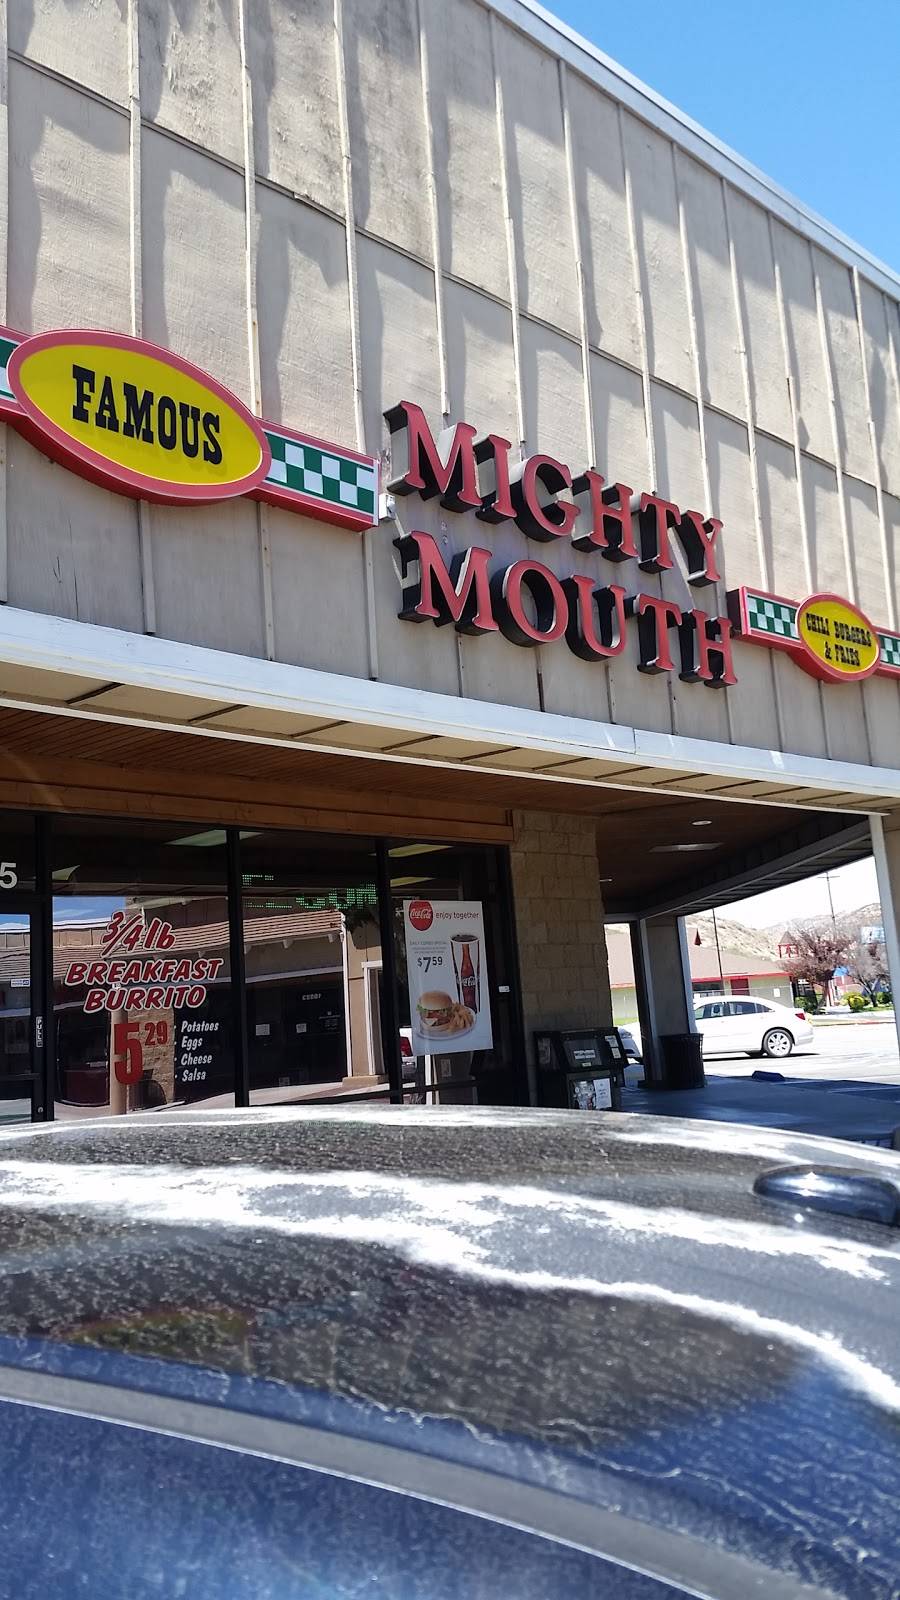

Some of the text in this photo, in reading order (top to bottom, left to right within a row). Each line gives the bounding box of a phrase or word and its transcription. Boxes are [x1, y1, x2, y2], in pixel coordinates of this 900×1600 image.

[72, 364, 223, 465] FAMOUS
[400, 399, 724, 583] MIGHTY
[410, 530, 739, 686] MOUTH
[806, 612, 872, 648] CHILI BURGERS
[825, 640, 861, 667] & FRIES
[435, 911, 452, 920] enjoy
[453, 911, 479, 920] together
[64, 958, 224, 987] BREAKFAST
[83, 984, 207, 1014] BURRITO
[181, 1020, 220, 1033] Potatoes
[181, 1035, 203, 1051] Eggs
[180, 1052, 213, 1066] Cheese
[182, 1068, 207, 1082] Salsa
